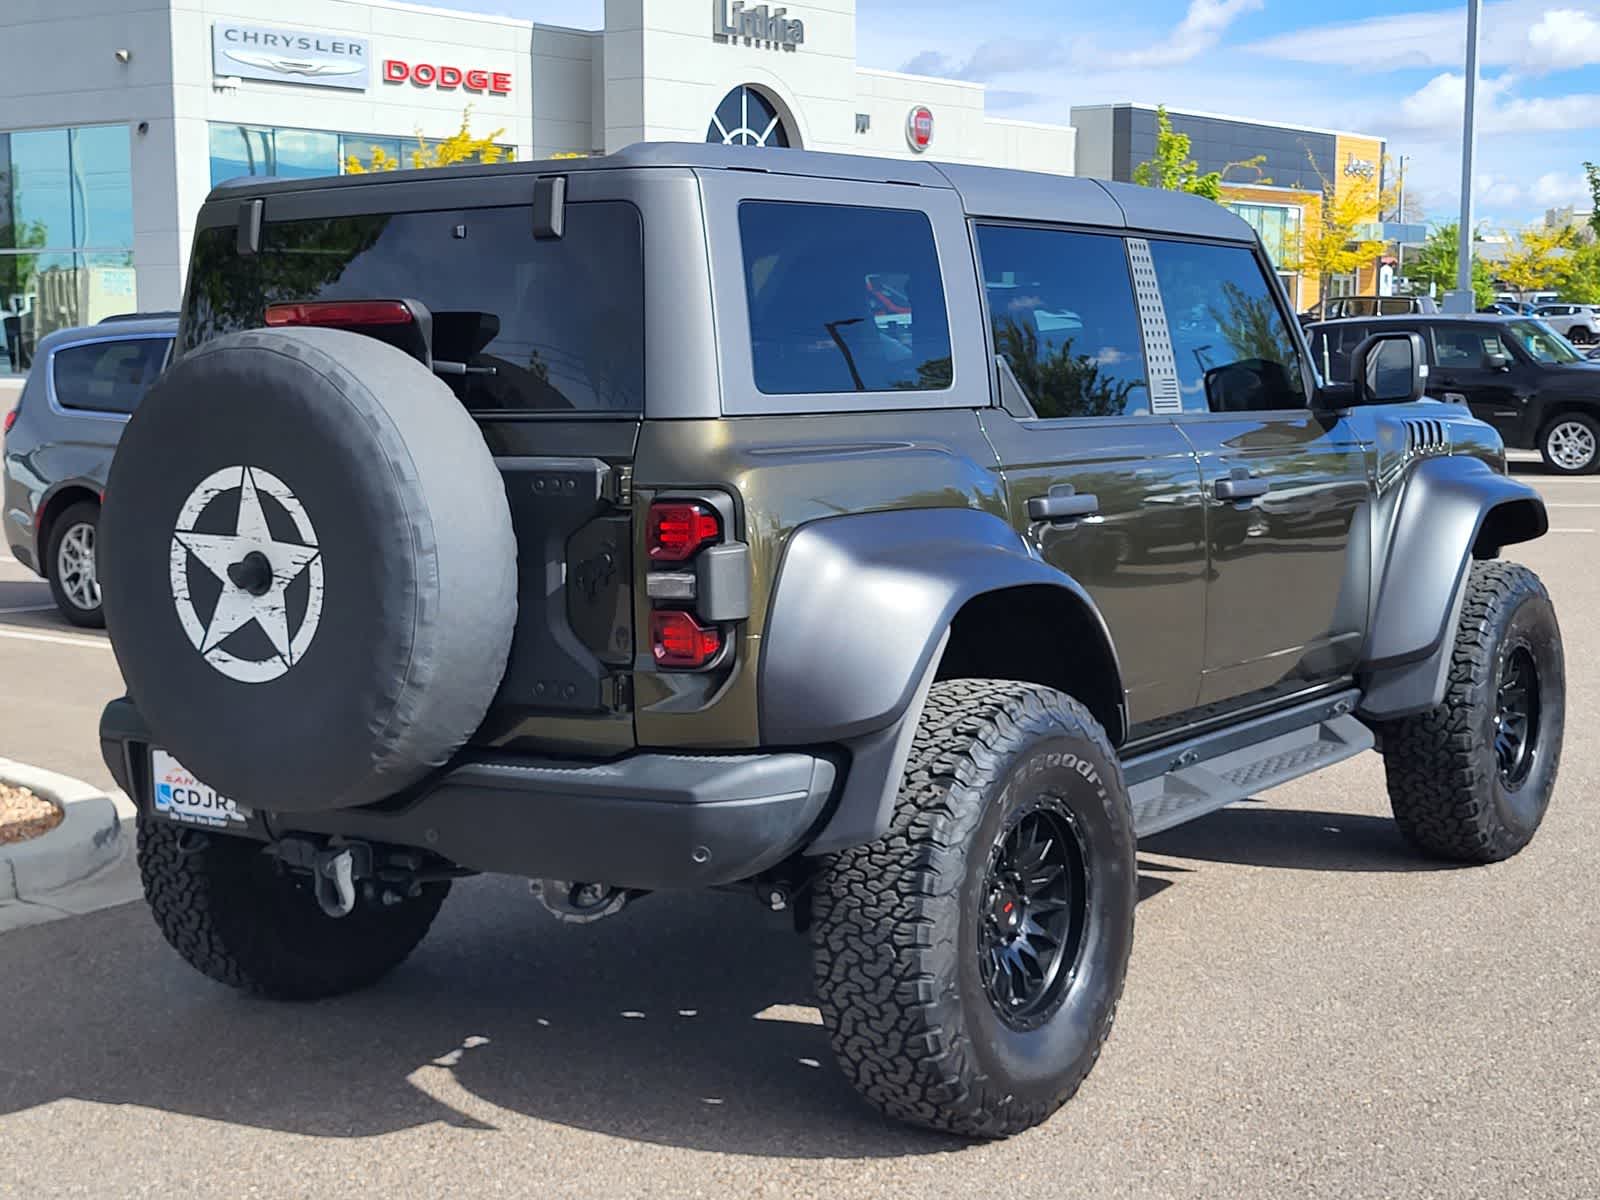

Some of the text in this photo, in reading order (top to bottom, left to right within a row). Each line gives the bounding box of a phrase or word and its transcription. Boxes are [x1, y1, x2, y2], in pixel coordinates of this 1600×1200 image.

[224, 28, 362, 56] CHRYSLER
[385, 59, 512, 94] DODGE
[172, 788, 228, 810] CDJR
